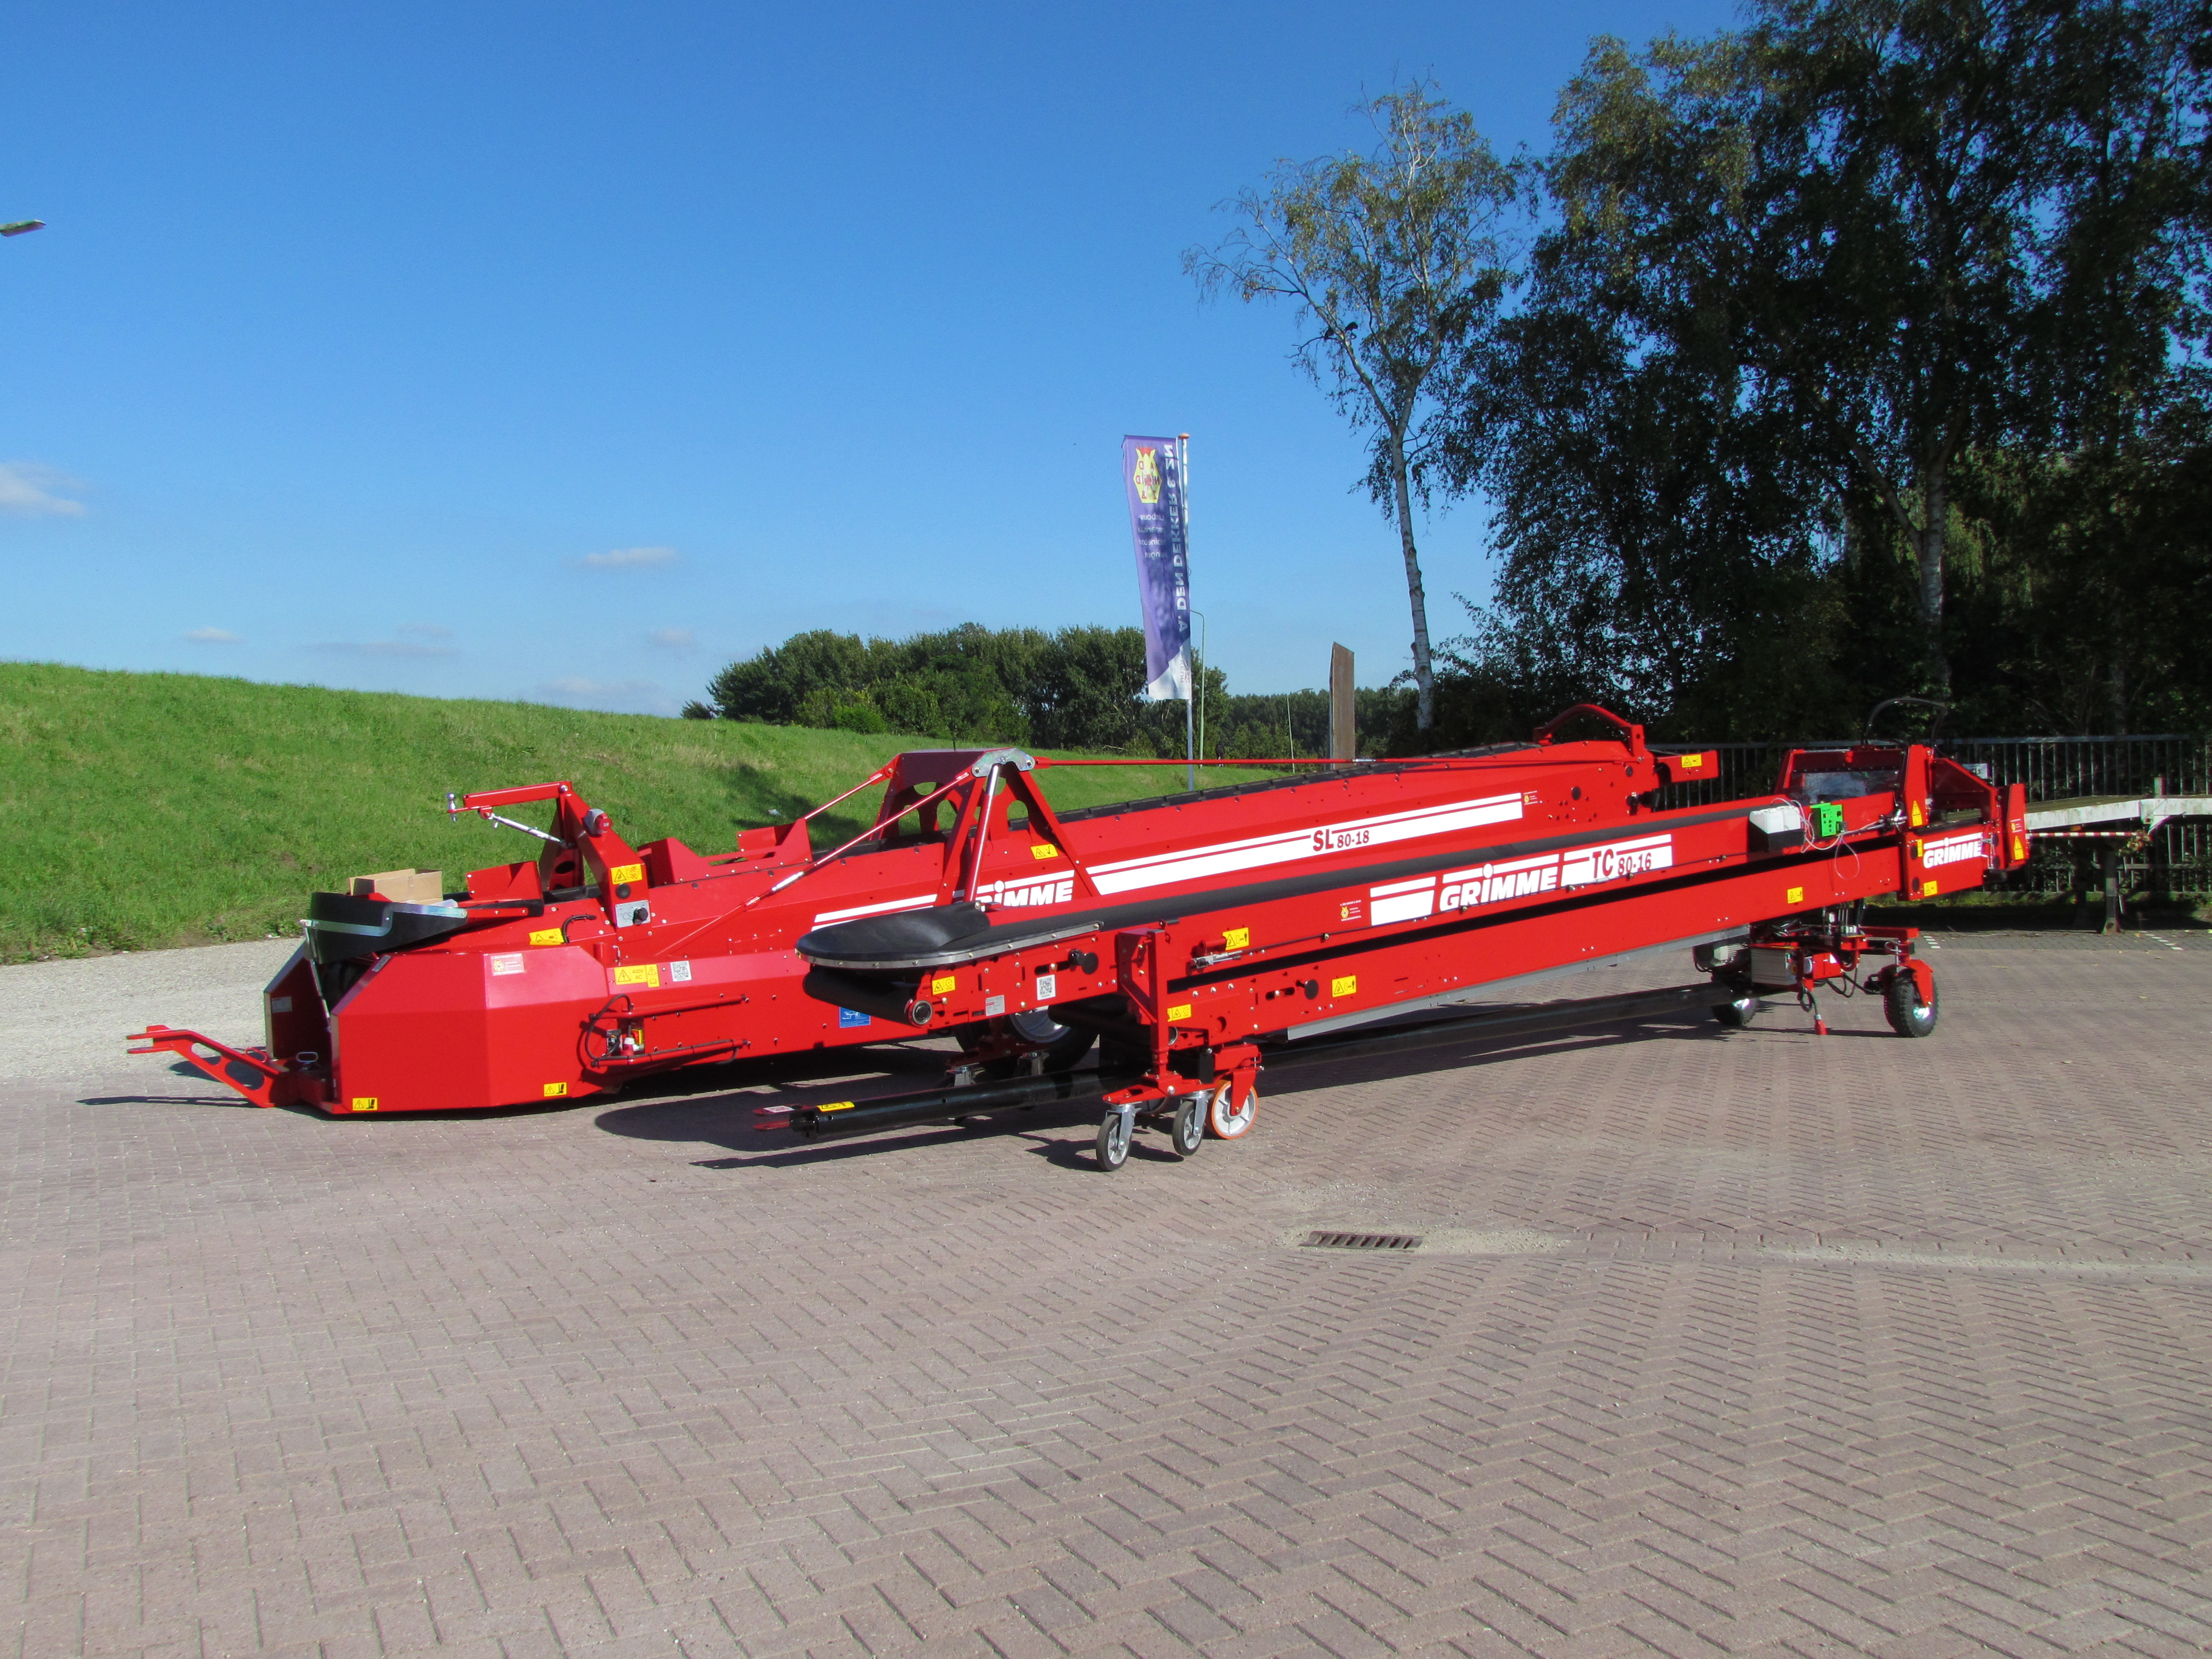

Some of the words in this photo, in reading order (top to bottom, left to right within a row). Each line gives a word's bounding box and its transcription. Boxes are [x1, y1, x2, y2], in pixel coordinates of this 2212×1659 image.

[1312, 828, 1334, 852] SL
[1337, 830, 1370, 848] 80-18
[1592, 848, 1614, 879] TC
[1618, 852, 1652, 876] 80-16
